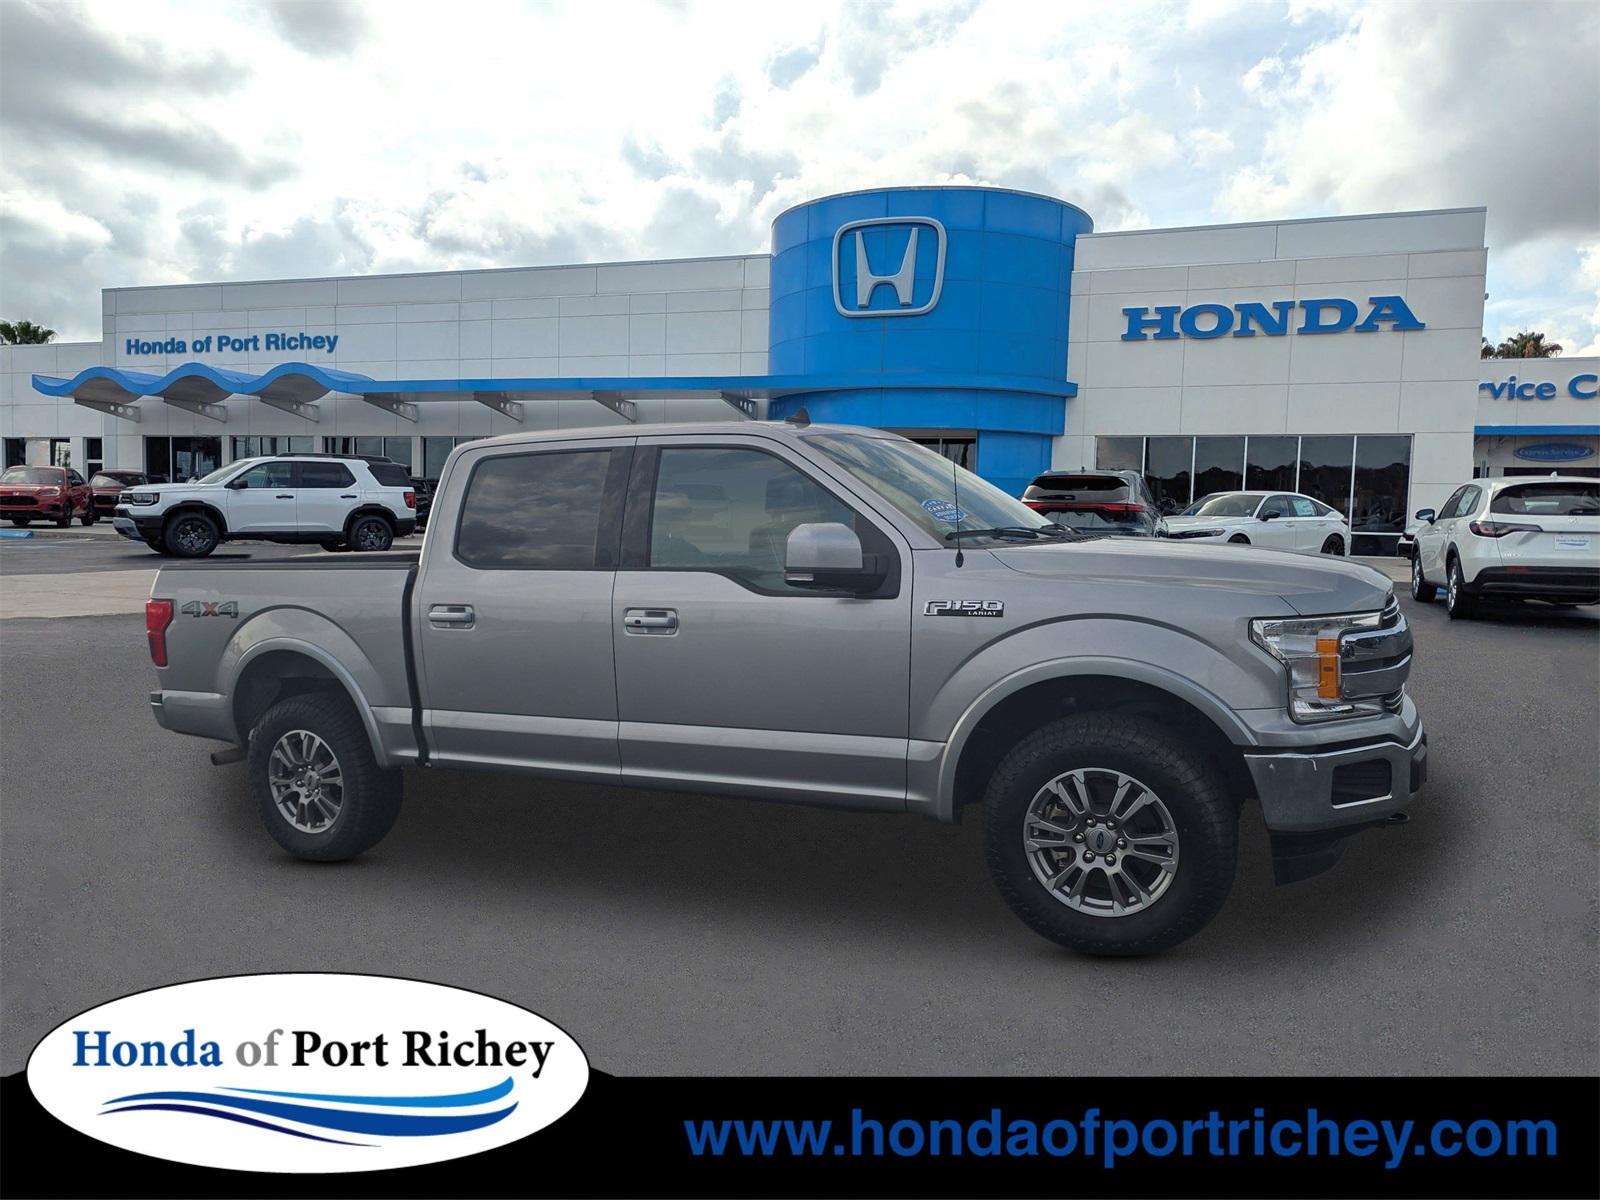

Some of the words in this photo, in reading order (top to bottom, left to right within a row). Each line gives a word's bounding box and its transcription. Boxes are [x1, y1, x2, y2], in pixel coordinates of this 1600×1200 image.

[1120, 295, 1426, 341] HONDA
[126, 337, 187, 355] Honda
[192, 336, 212, 353] of
[217, 335, 260, 352] Port
[265, 332, 339, 354] Richey
[1568, 374, 1600, 400] C
[1551, 447, 1579, 456] Service
